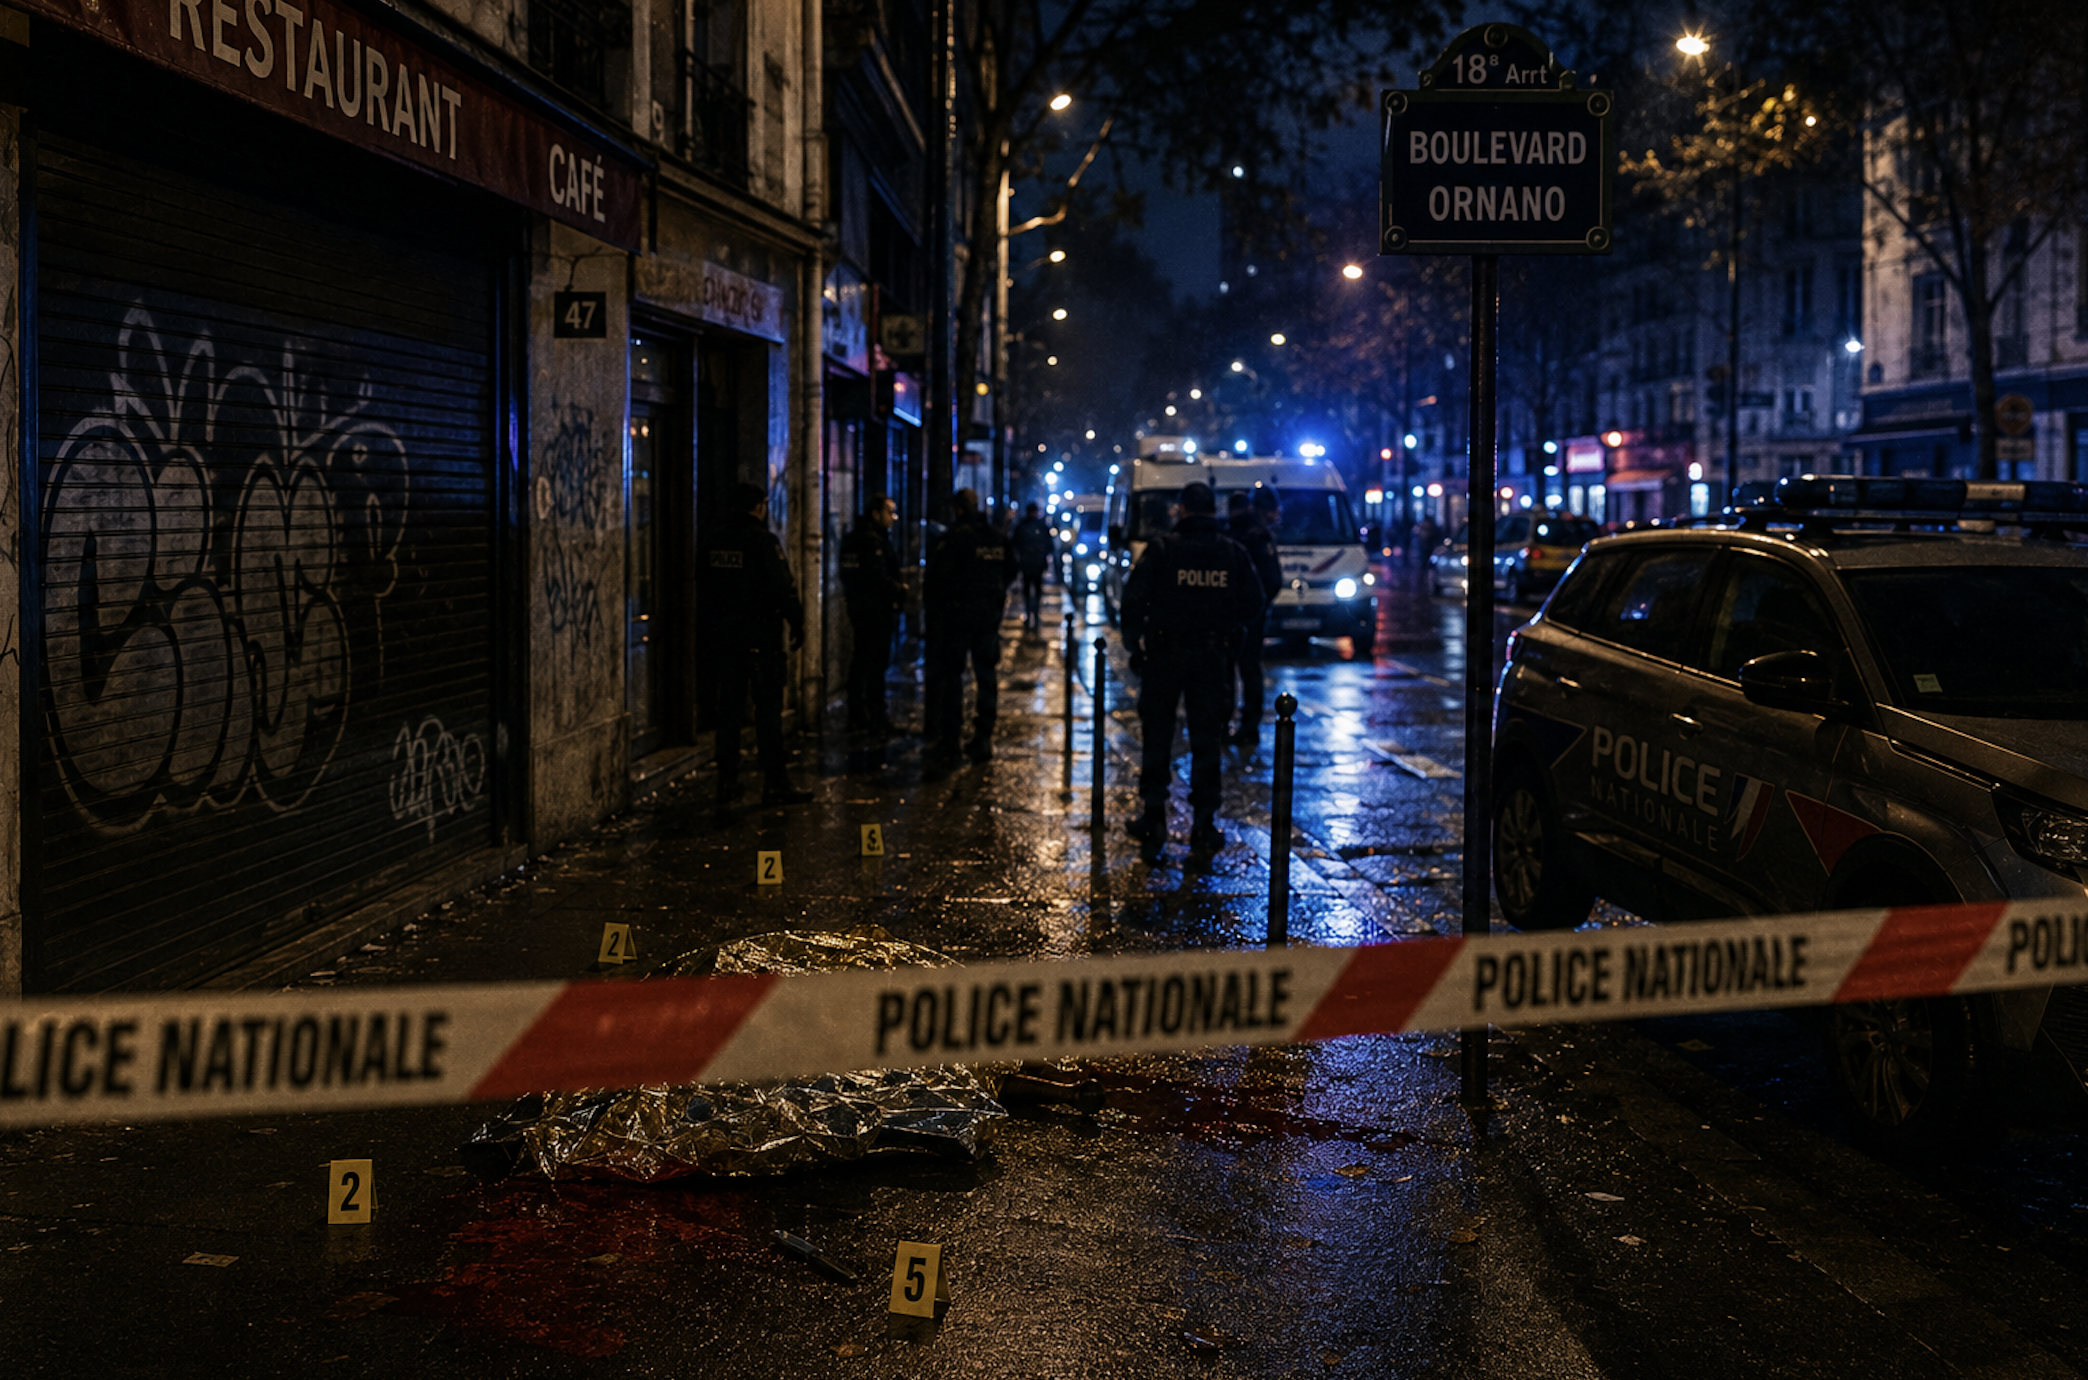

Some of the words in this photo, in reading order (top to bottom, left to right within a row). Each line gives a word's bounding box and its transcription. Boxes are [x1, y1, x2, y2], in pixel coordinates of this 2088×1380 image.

[1505, 62, 1548, 84] Arrt
[1409, 130, 1587, 165] BOULEVARD
[549, 142, 606, 223] CAFÉ
[1428, 185, 1566, 222] ORNANO
[564, 301, 597, 330] 47
[1177, 569, 1228, 587] POLICE
[1592, 725, 1721, 817] POLICE
[1591, 774, 1719, 852] NATIONALE
[765, 857, 775, 878] 2
[608, 931, 618, 956] 2
[2008, 915, 2088, 974] POLI
[1475, 949, 1609, 1008] POLICE
[1626, 936, 1806, 999] NATIONALE
[877, 985, 1040, 1054] POLICE
[1058, 970, 1290, 1040] NATIONALE
[0, 1019, 136, 1097] LICE
[157, 1012, 447, 1093] NATIONALE
[341, 1171, 360, 1211] 2
[905, 1257, 925, 1301] 5
